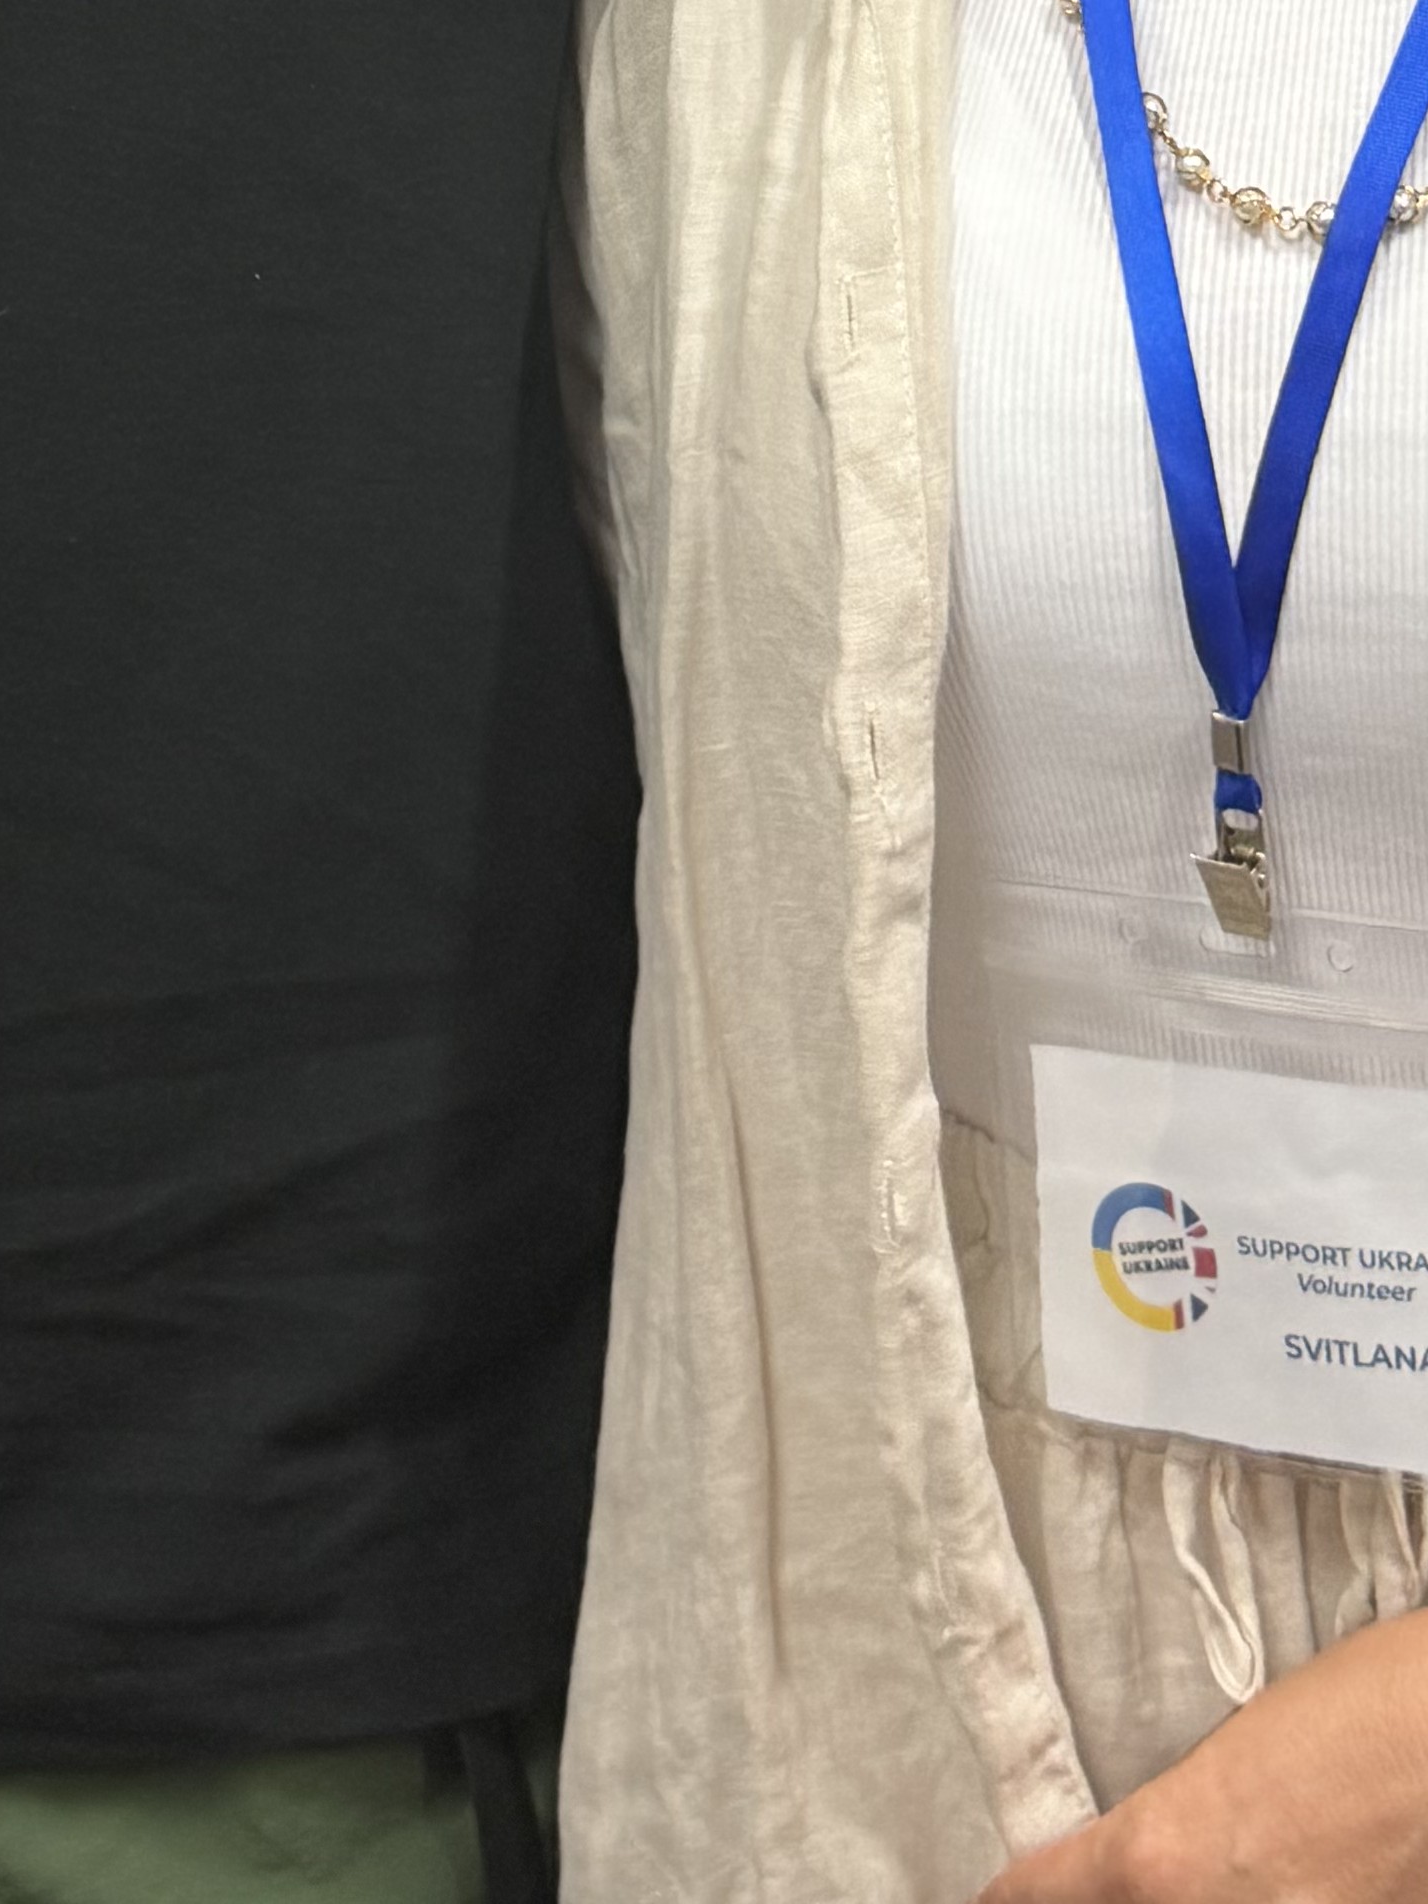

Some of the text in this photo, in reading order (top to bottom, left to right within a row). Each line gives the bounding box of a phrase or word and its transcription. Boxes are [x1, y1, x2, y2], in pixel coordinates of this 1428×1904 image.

[1117, 1237, 1185, 1256] SUPPORT
[1236, 1235, 1351, 1267] SUPPORT
[1122, 1255, 1190, 1275] UKRAINE
[1297, 1272, 1418, 1302] Volunteer
